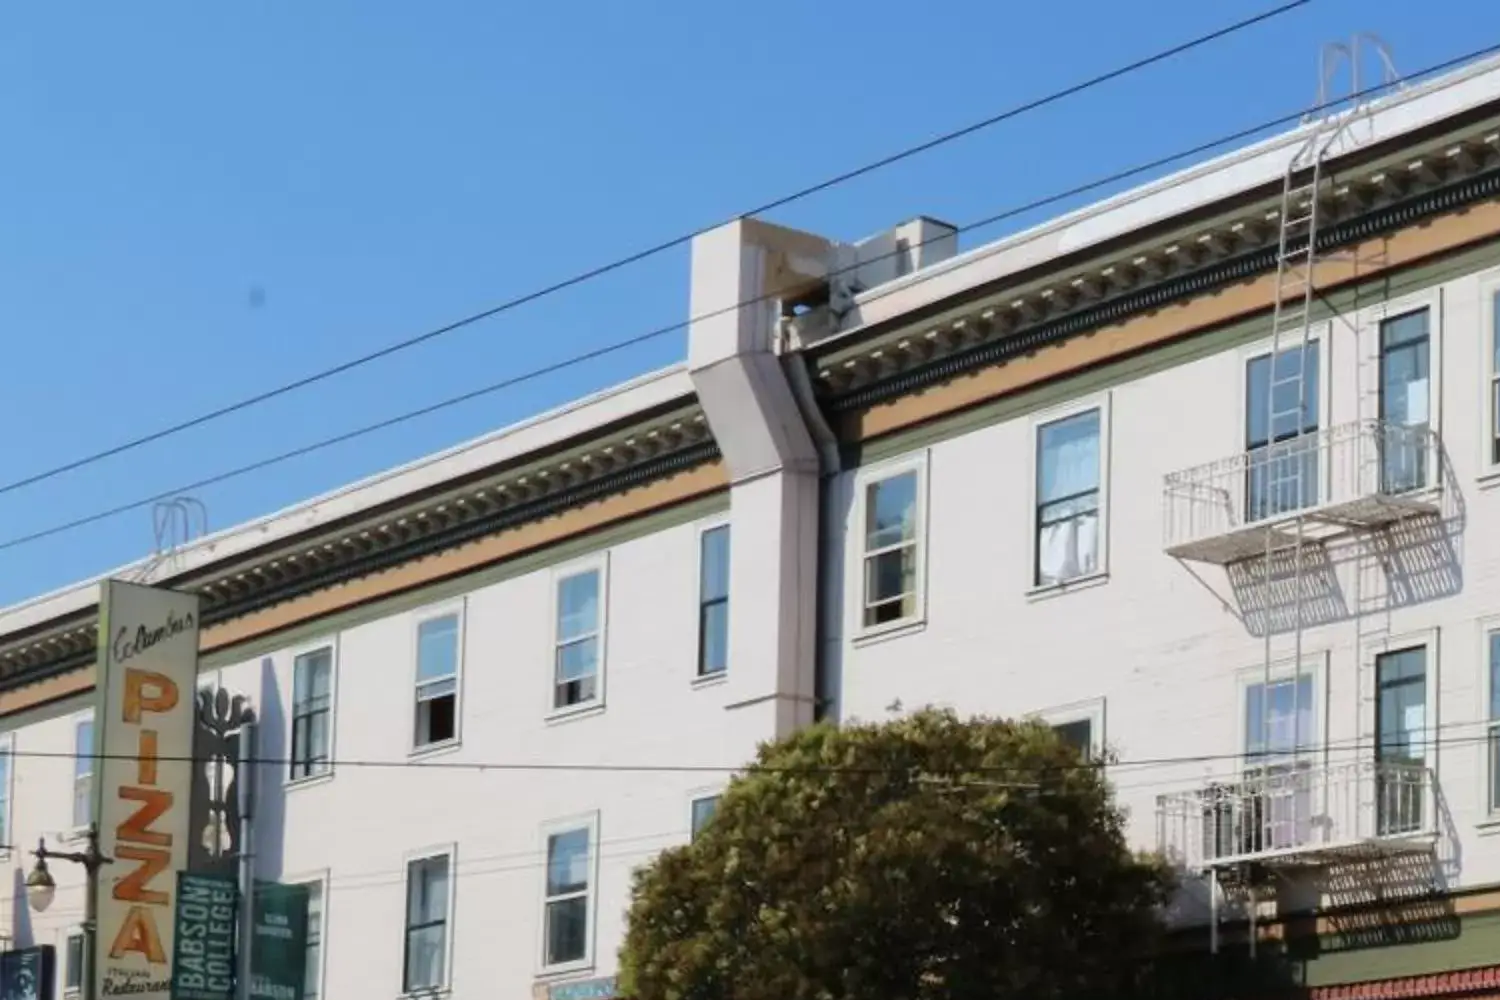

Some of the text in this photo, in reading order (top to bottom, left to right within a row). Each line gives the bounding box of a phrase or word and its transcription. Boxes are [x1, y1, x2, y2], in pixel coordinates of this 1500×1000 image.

[108, 668, 180, 965] PIZZA
[178, 882, 212, 989] BABSON
[206, 889, 234, 991] COLLEGE
